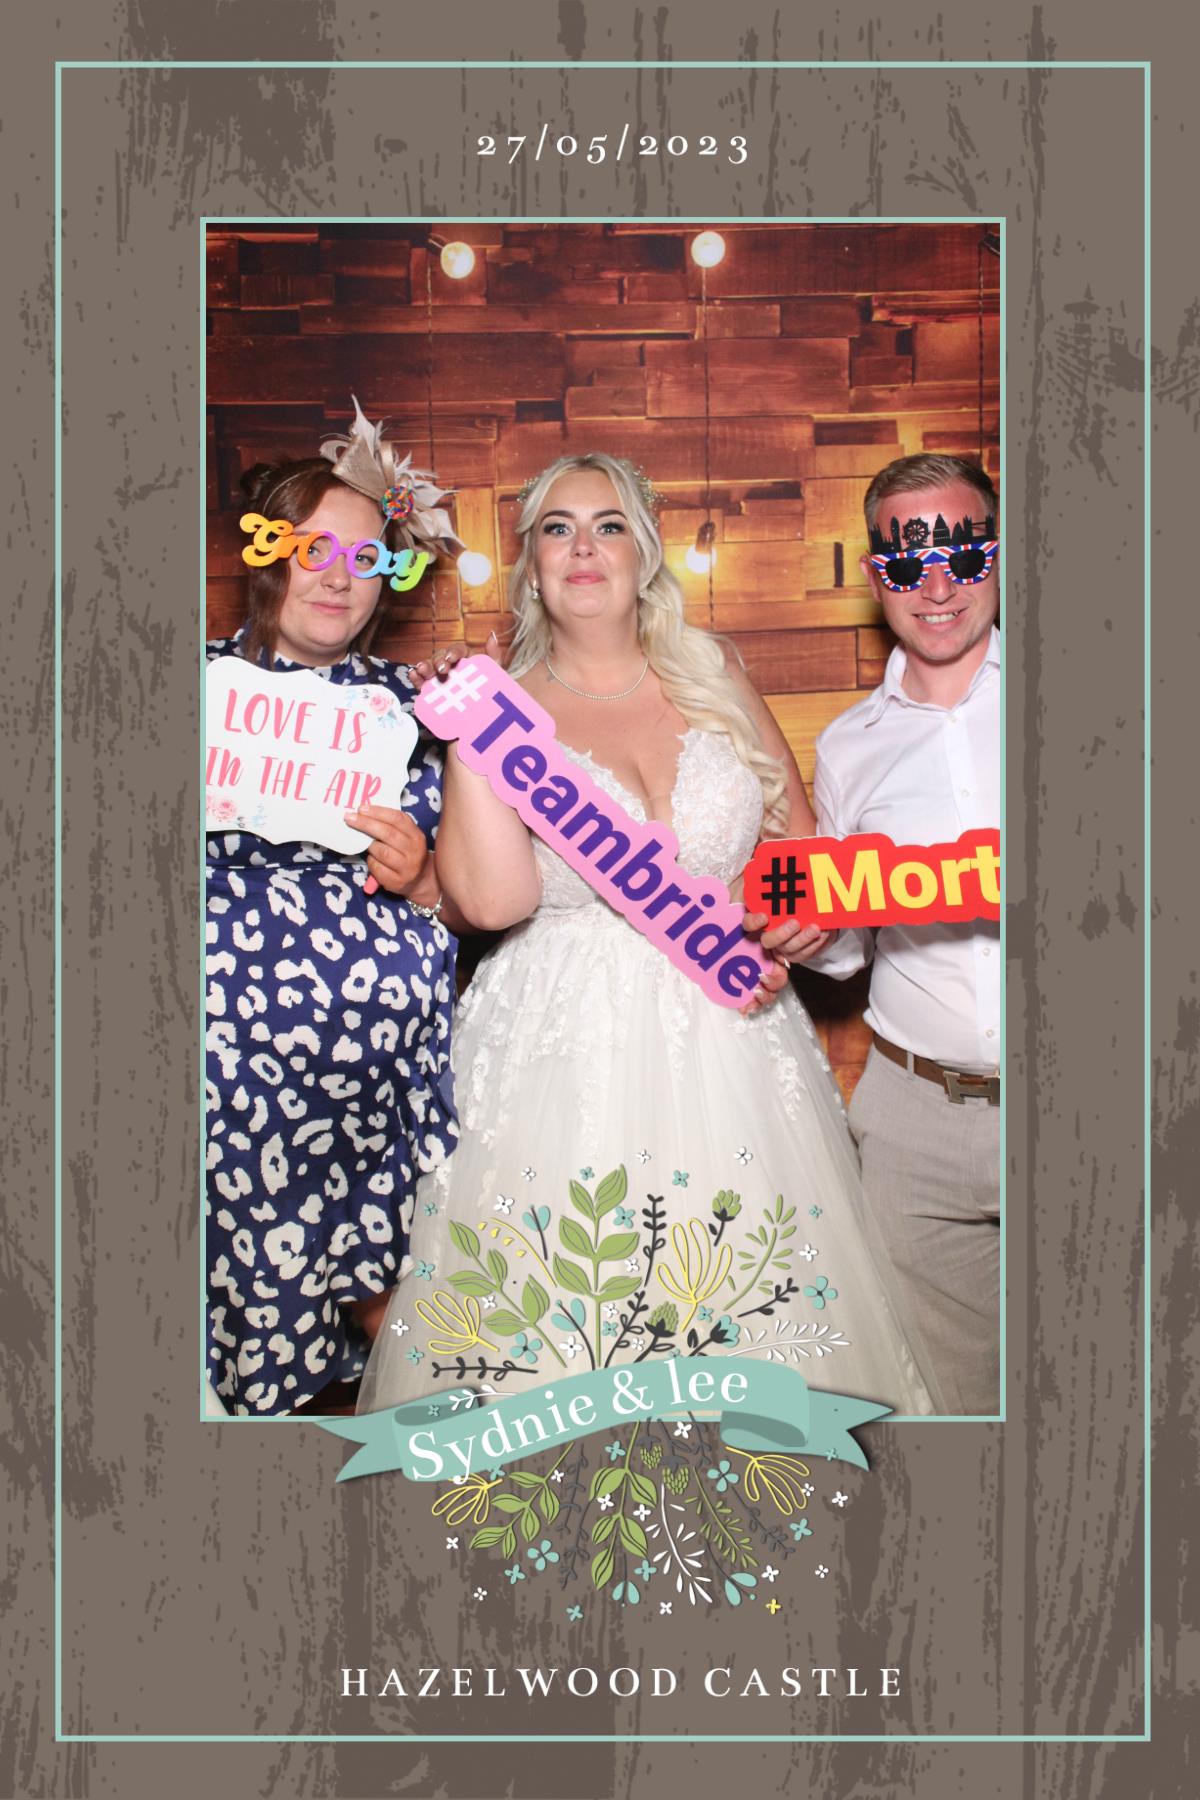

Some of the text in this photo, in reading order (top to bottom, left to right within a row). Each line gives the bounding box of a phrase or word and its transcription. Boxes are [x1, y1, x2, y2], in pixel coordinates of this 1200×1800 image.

[224, 688, 369, 754] LOVE IS
[259, 755, 316, 801] THE
[322, 768, 382, 810] AIR
[423, 663, 762, 998] #Teambride
[761, 845, 1000, 916] #Mort
